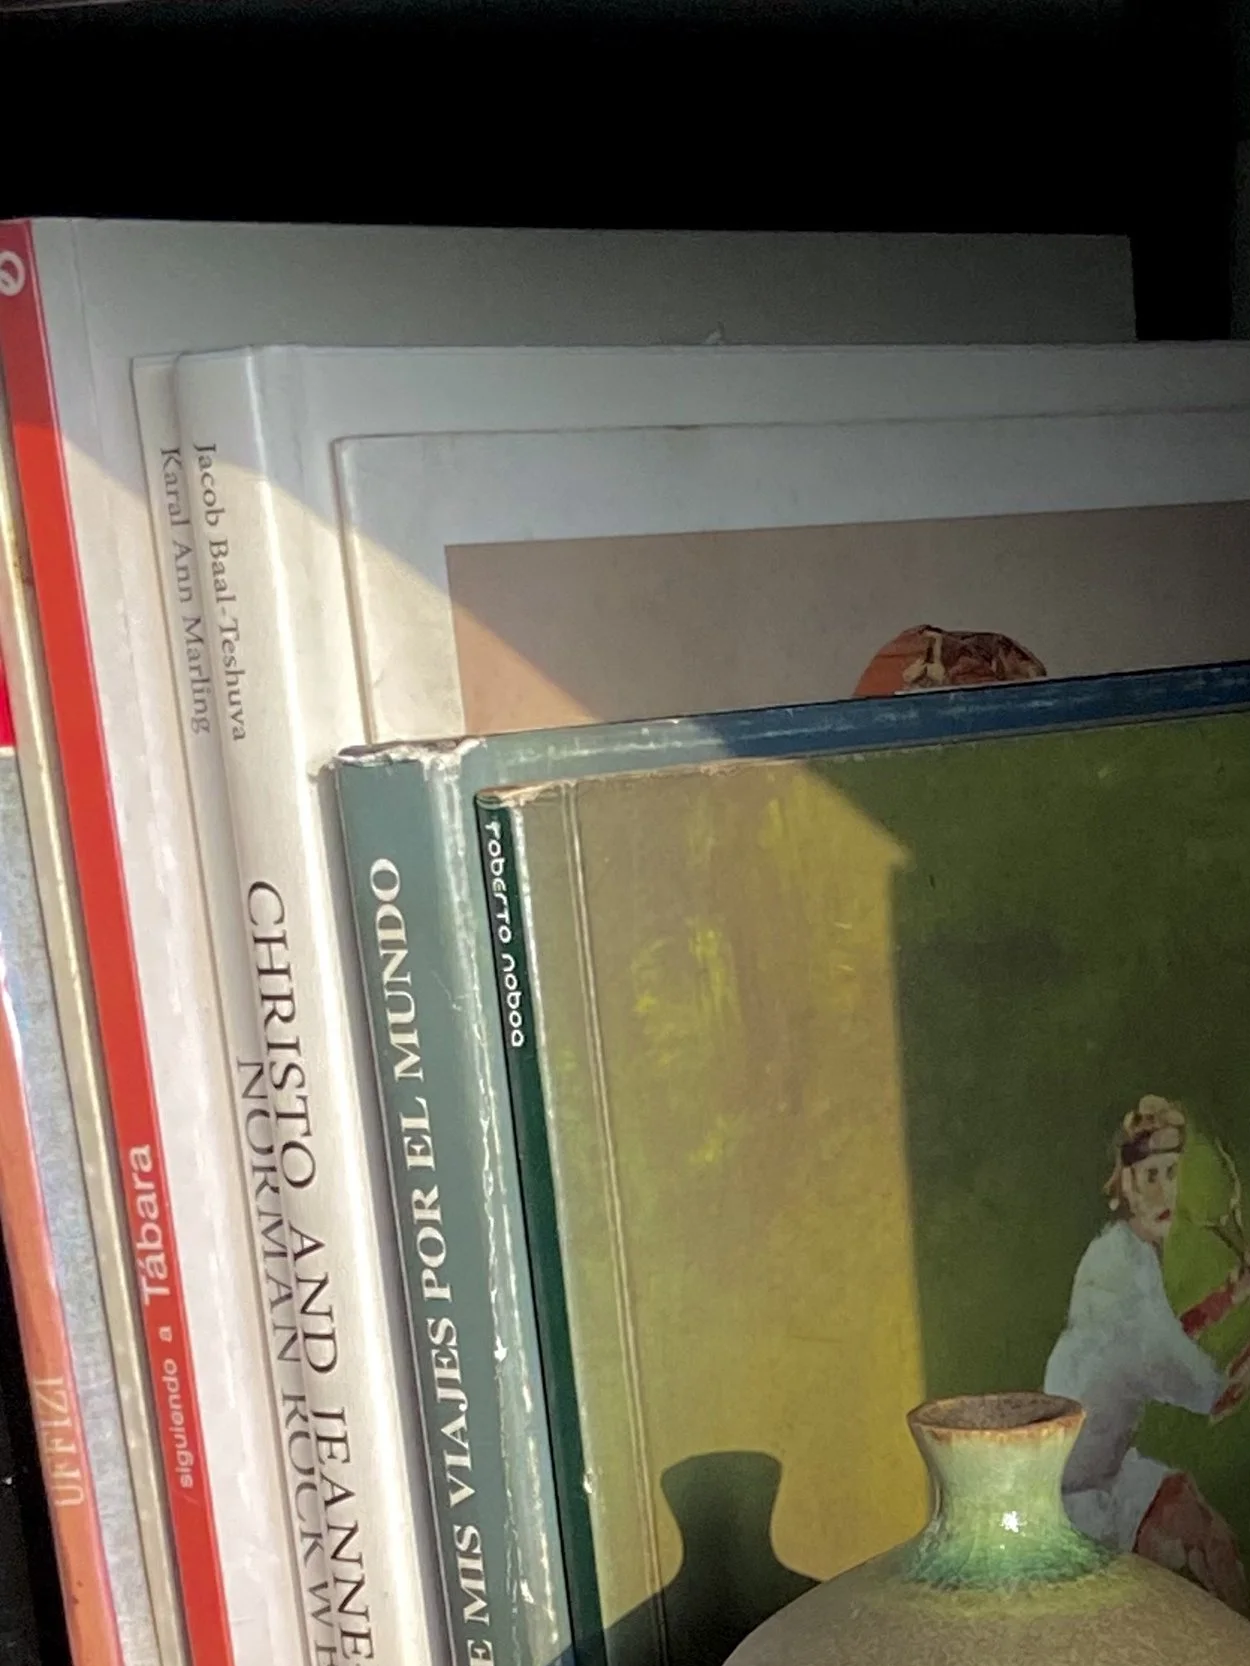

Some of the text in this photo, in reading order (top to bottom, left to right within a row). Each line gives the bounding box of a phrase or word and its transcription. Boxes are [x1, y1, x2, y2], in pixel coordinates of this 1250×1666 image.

[160, 447, 212, 736] Karal Ann Marling
[193, 443, 247, 742] Jacob Baal-Teshuva
[370, 857, 425, 1083] MUNDO
[248, 880, 317, 1190] CHRISTO
[289, 1219, 338, 1374] AND
[401, 1095, 438, 1173] EL
[129, 1142, 194, 1490] siguiendo a Tábara
[415, 1183, 454, 1304] POR
[34, 1376, 86, 1507] UFFIZI
[426, 1314, 477, 1510] VIAJES
[454, 1522, 498, 1626] MIS
